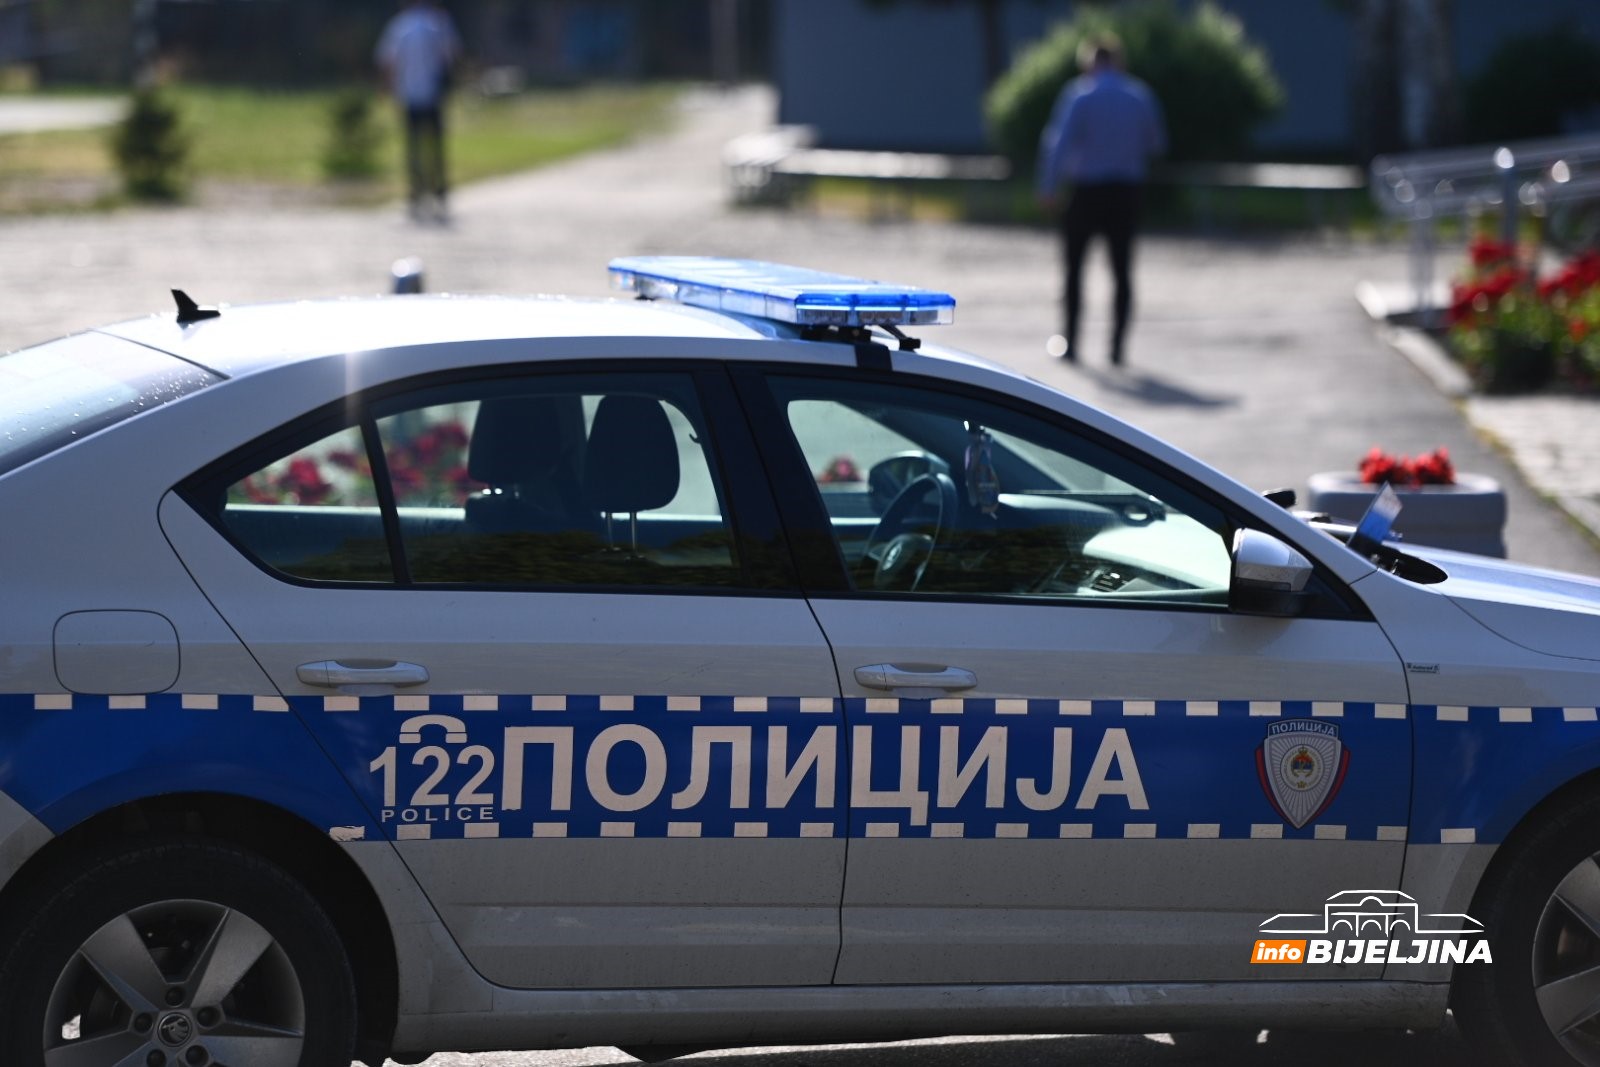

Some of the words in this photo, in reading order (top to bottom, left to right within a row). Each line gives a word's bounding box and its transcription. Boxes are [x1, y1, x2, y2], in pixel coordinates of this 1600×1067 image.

[1272, 722, 1336, 736] ПОЛИЦИЈА
[369, 745, 495, 807] 122
[501, 723, 1150, 826] ПОЛИЦИЈА
[381, 806, 494, 822] POLICE
